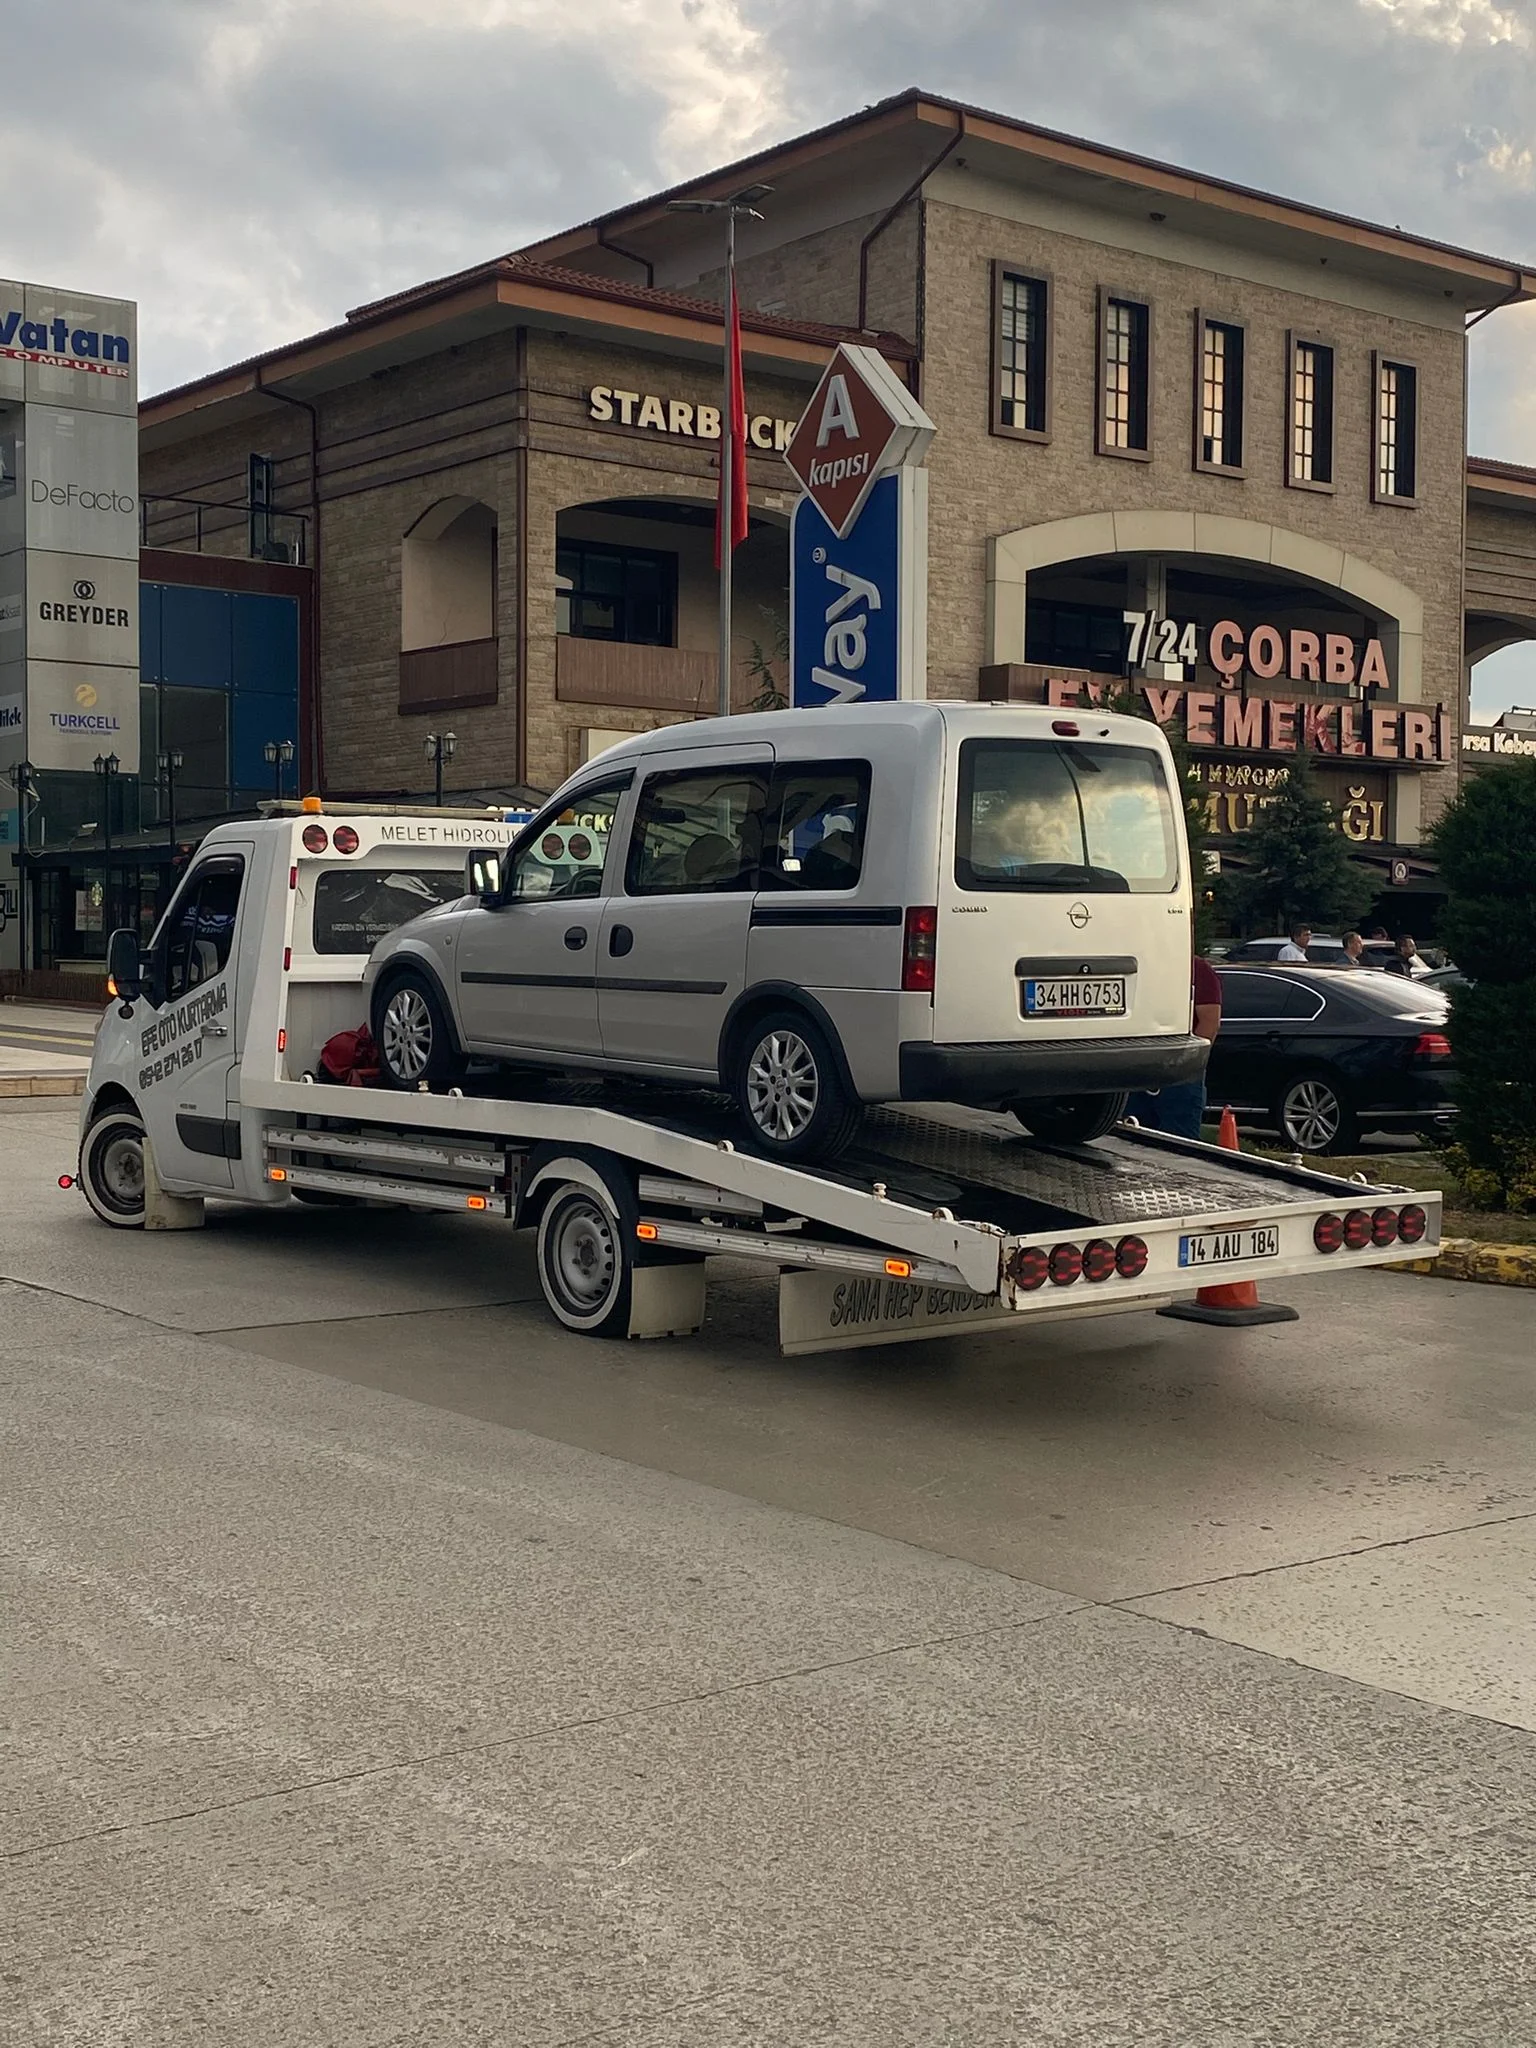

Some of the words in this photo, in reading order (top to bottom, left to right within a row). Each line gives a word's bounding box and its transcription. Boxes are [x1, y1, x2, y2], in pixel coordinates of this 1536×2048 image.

[0, 311, 129, 363] Vatan
[589, 385, 798, 452] STARBCK
[815, 373, 861, 449] A
[808, 452, 870, 490] kapısı
[31, 479, 135, 514] DeFacto
[39, 602, 129, 627] GREYDER
[1123, 609, 1198, 669] 7/24
[1209, 619, 1391, 690] ÇORBA
[49, 713, 121, 730] TURKCELL
[1494, 732, 1536, 758] Keba
[381, 825, 437, 841] MELET
[1036, 983, 1057, 1007] 34
[1083, 983, 1121, 1006] 6753
[141, 1024, 159, 1058] EFE
[158, 1013, 178, 1047] OTO
[177, 982, 228, 1037] KURTARMA
[164, 1051, 181, 1078] 274
[181, 1043, 194, 1068] 26
[1190, 1238, 1206, 1262] 14
[1212, 1233, 1241, 1259] AAU
[1251, 1229, 1275, 1254] 184
[830, 1278, 880, 1327] SANA
[883, 1282, 923, 1319] HEP
